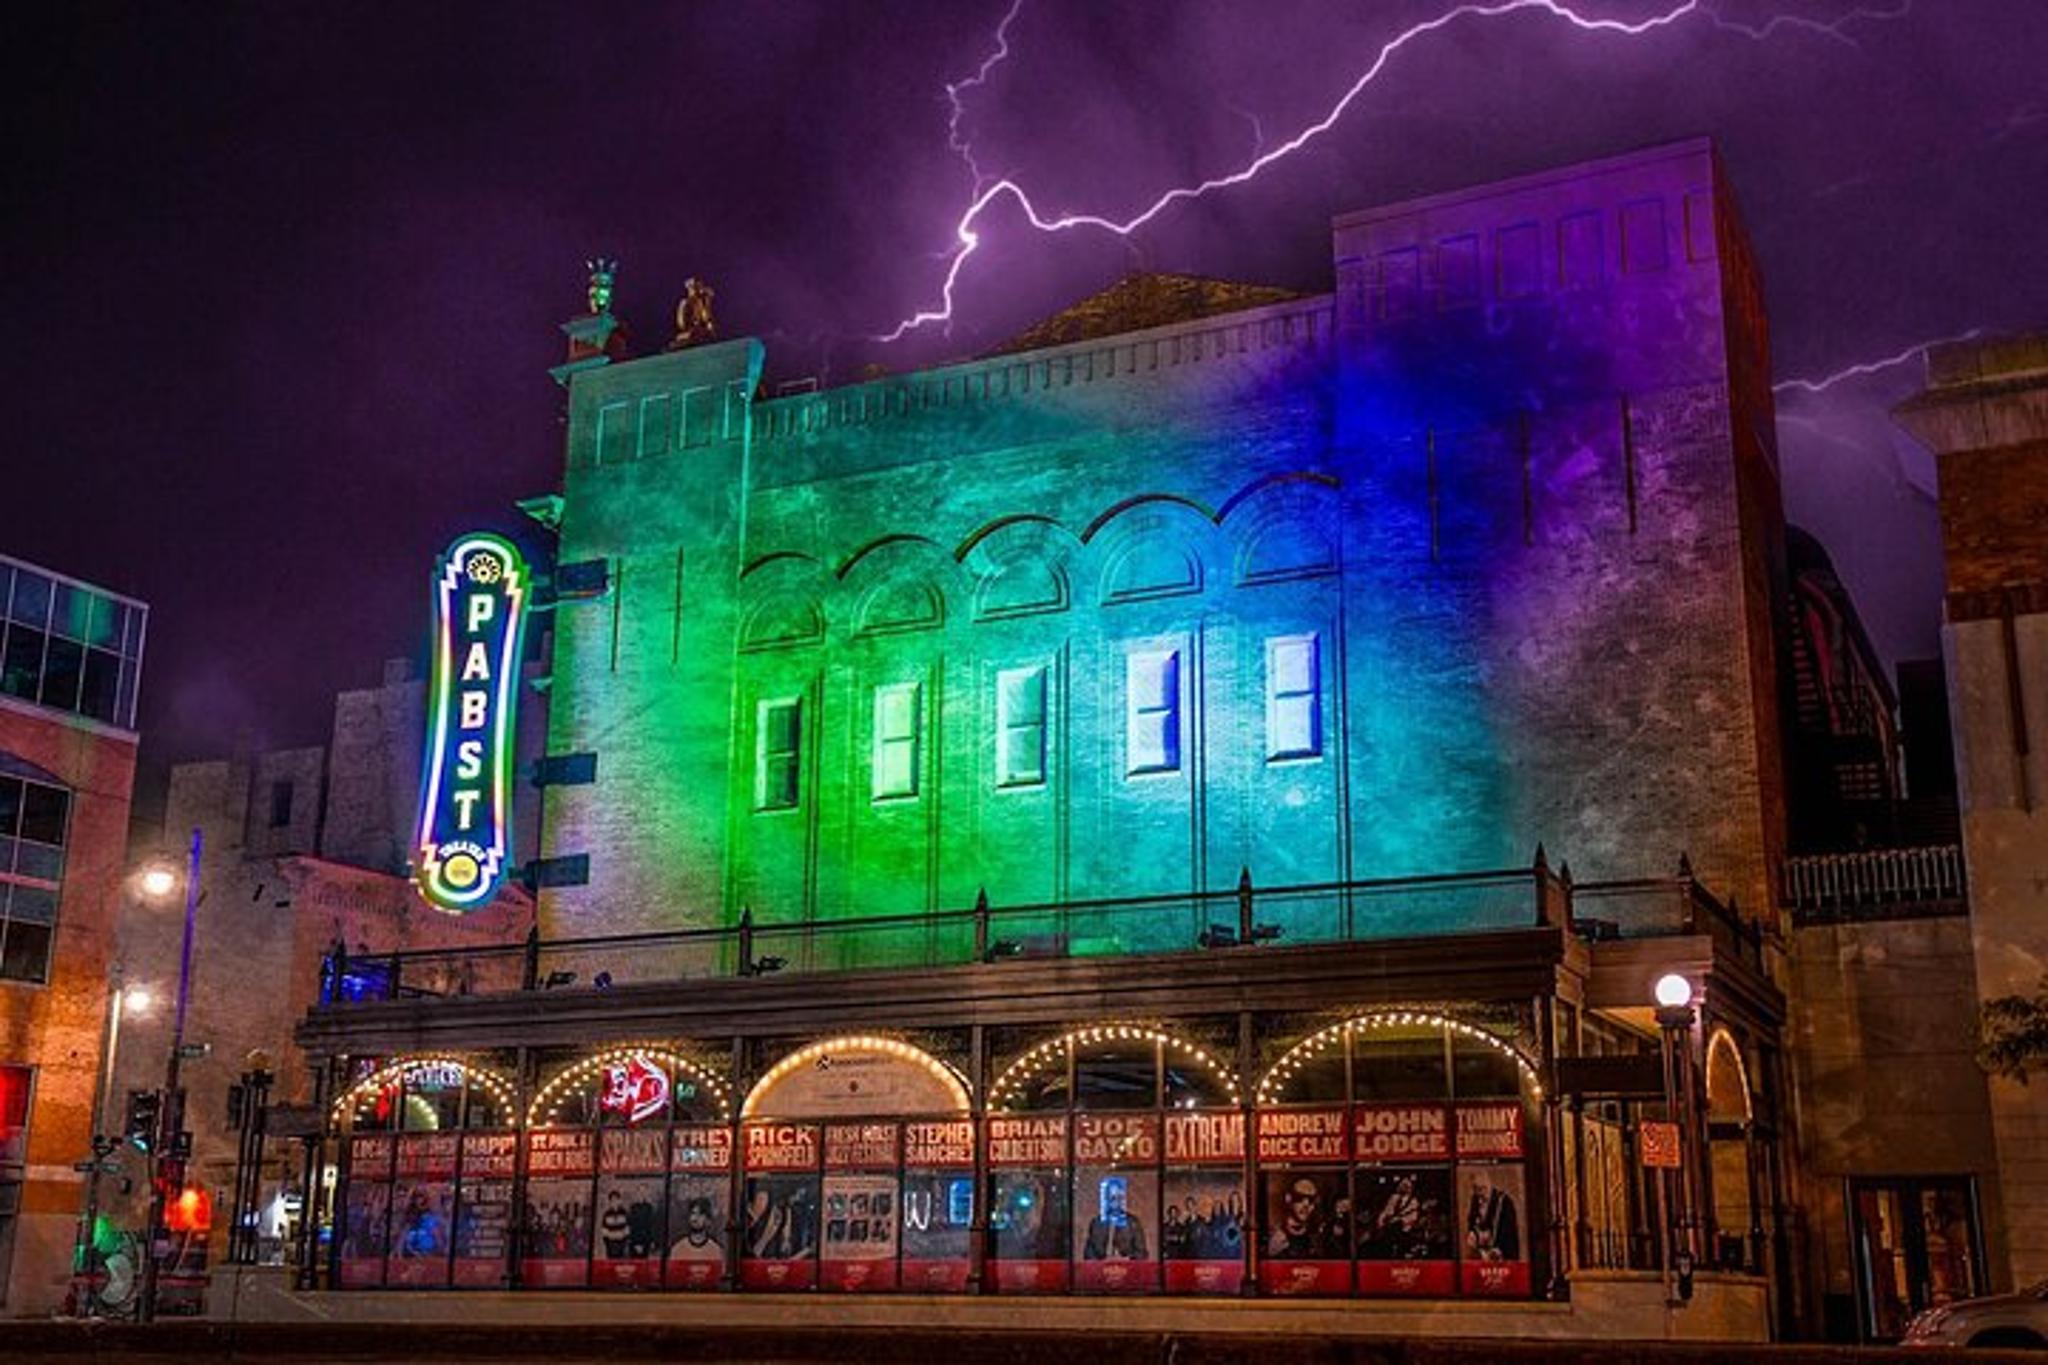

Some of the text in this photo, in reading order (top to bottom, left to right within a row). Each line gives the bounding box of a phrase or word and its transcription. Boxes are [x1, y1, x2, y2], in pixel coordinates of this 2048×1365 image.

[454, 594, 494, 831] PABST
[991, 1120, 1065, 1138] BRIAN
[1086, 1119, 1143, 1136] JOE
[1259, 1113, 1343, 1135] ANDREW
[1356, 1110, 1445, 1133] JOHN
[1455, 1108, 1518, 1130] TOMMY
[750, 1127, 815, 1145] RICK
[1259, 1136, 1343, 1156] DICE CLAY
[1357, 1133, 1445, 1154] LODGE
[1077, 1137, 1155, 1160] GATTO
